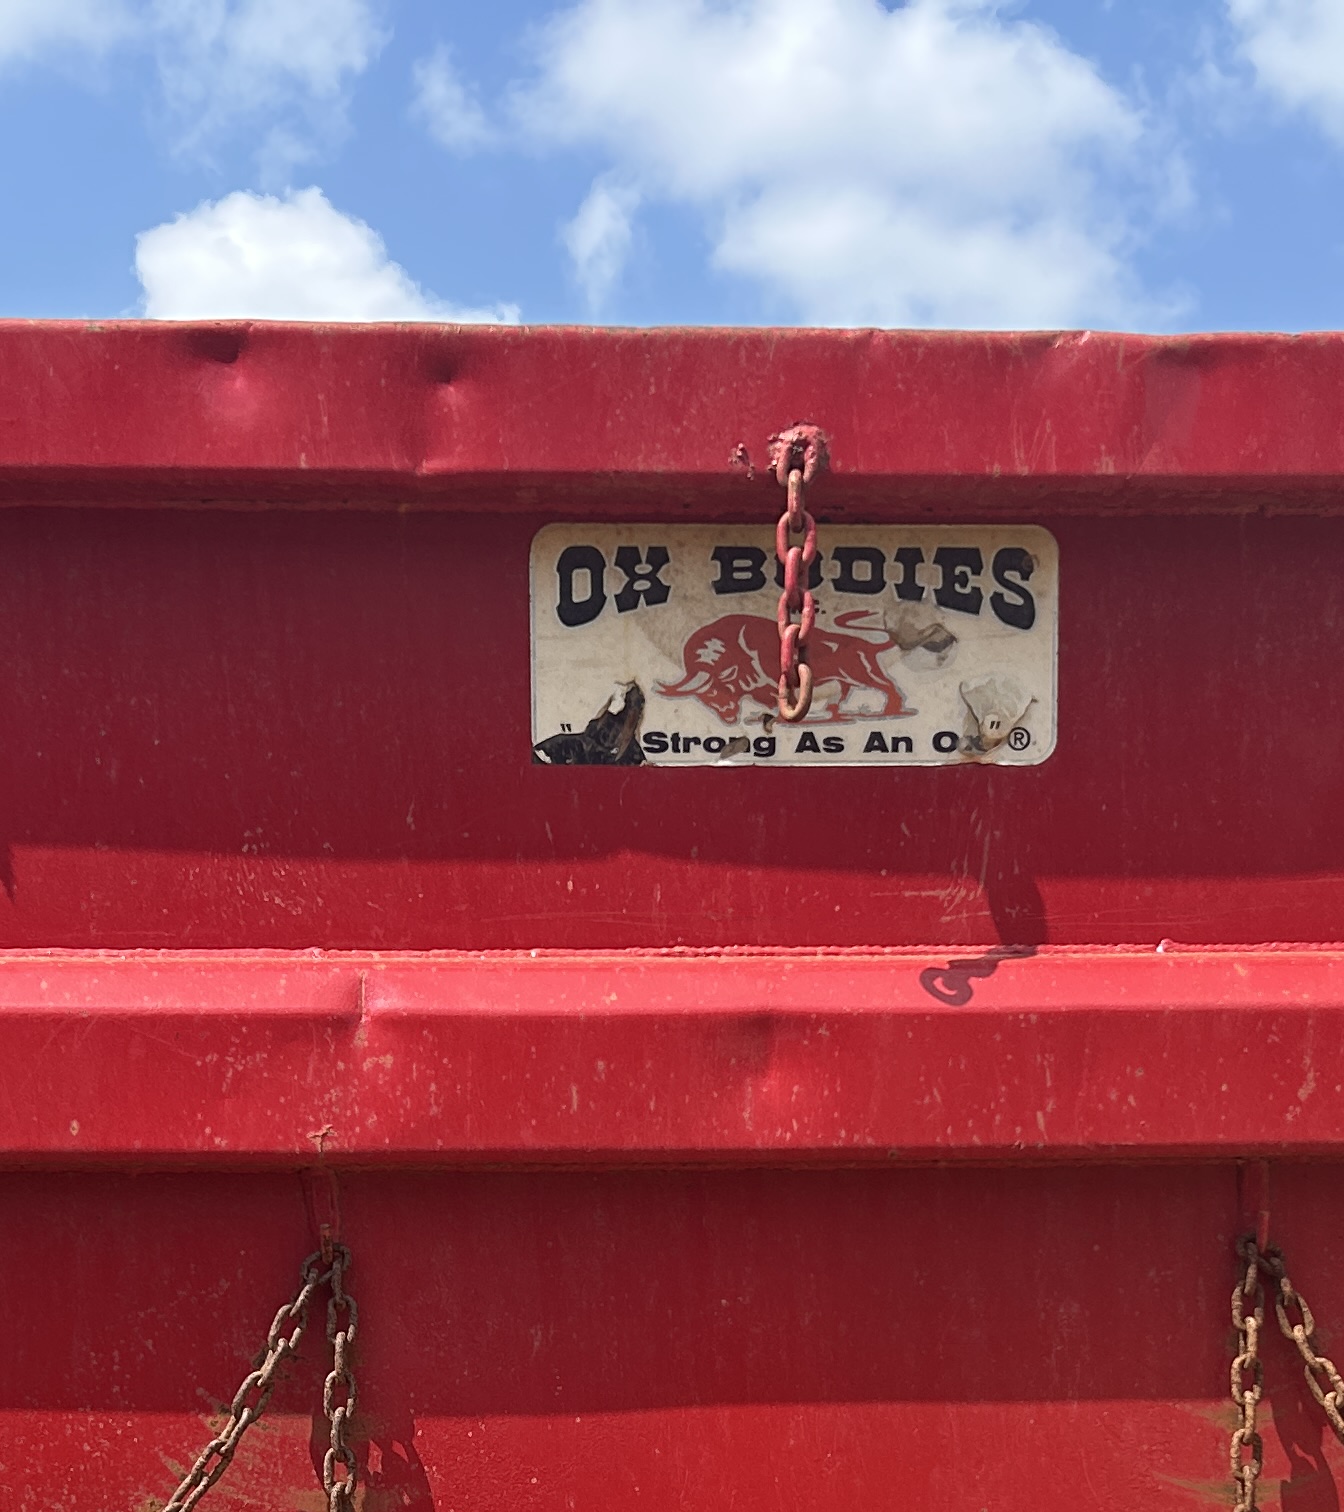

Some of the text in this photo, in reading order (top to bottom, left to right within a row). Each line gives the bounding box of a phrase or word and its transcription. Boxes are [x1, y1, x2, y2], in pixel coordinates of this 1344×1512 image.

[556, 545, 671, 627] OX
[795, 731, 845, 753] As
[863, 731, 913, 753] An
